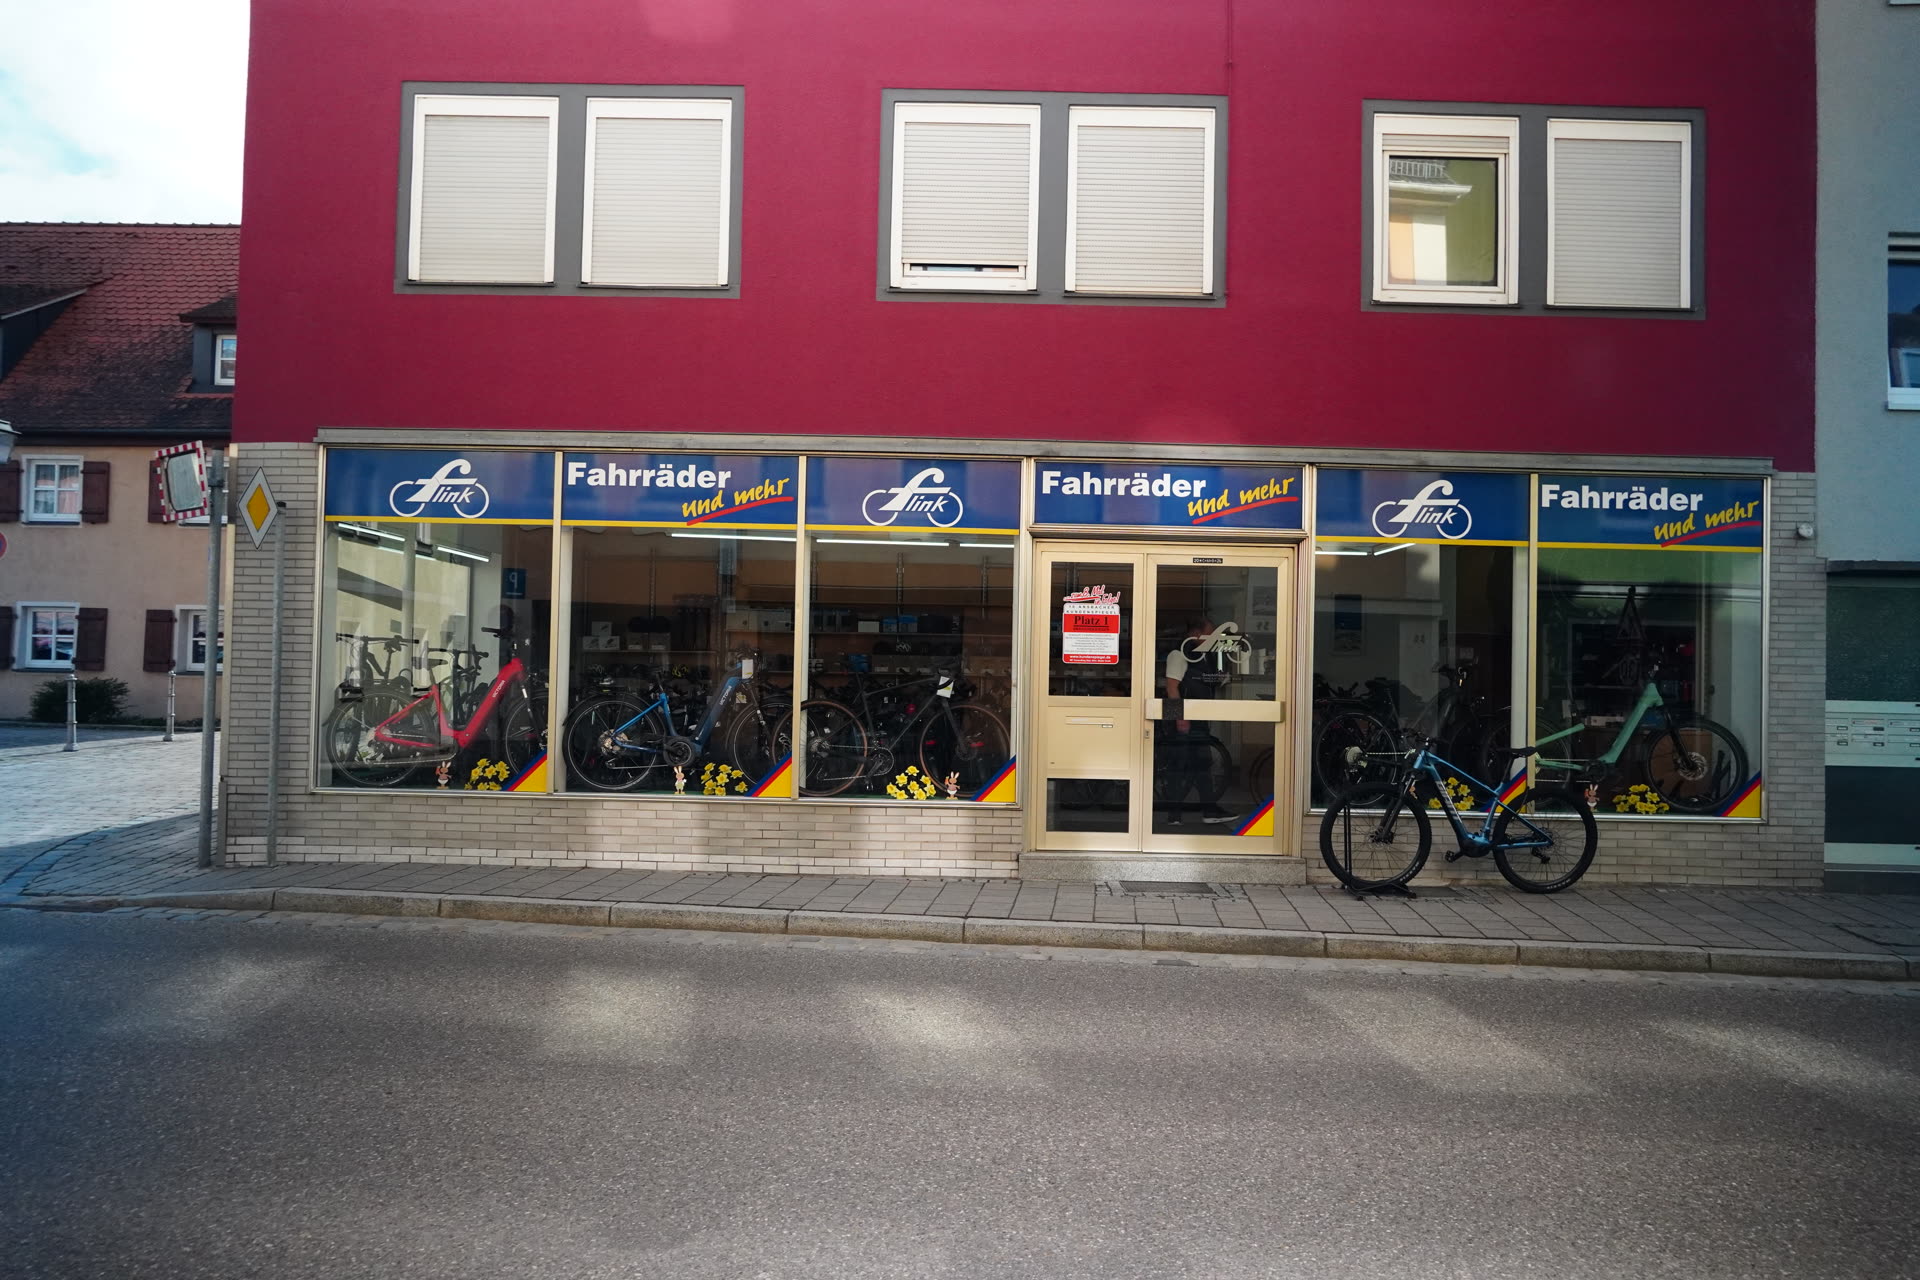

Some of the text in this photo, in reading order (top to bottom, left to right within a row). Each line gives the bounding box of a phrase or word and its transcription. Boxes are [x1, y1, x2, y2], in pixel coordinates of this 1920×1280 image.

[567, 462, 732, 489] Fahrräder
[1042, 470, 1207, 498] Fahrräder
[681, 477, 790, 518] und mehr
[1187, 477, 1296, 517] und mehr
[1541, 484, 1704, 512] Fahrräder
[1653, 500, 1760, 541] und mehr
[1074, 615, 1109, 625] Platz 1
